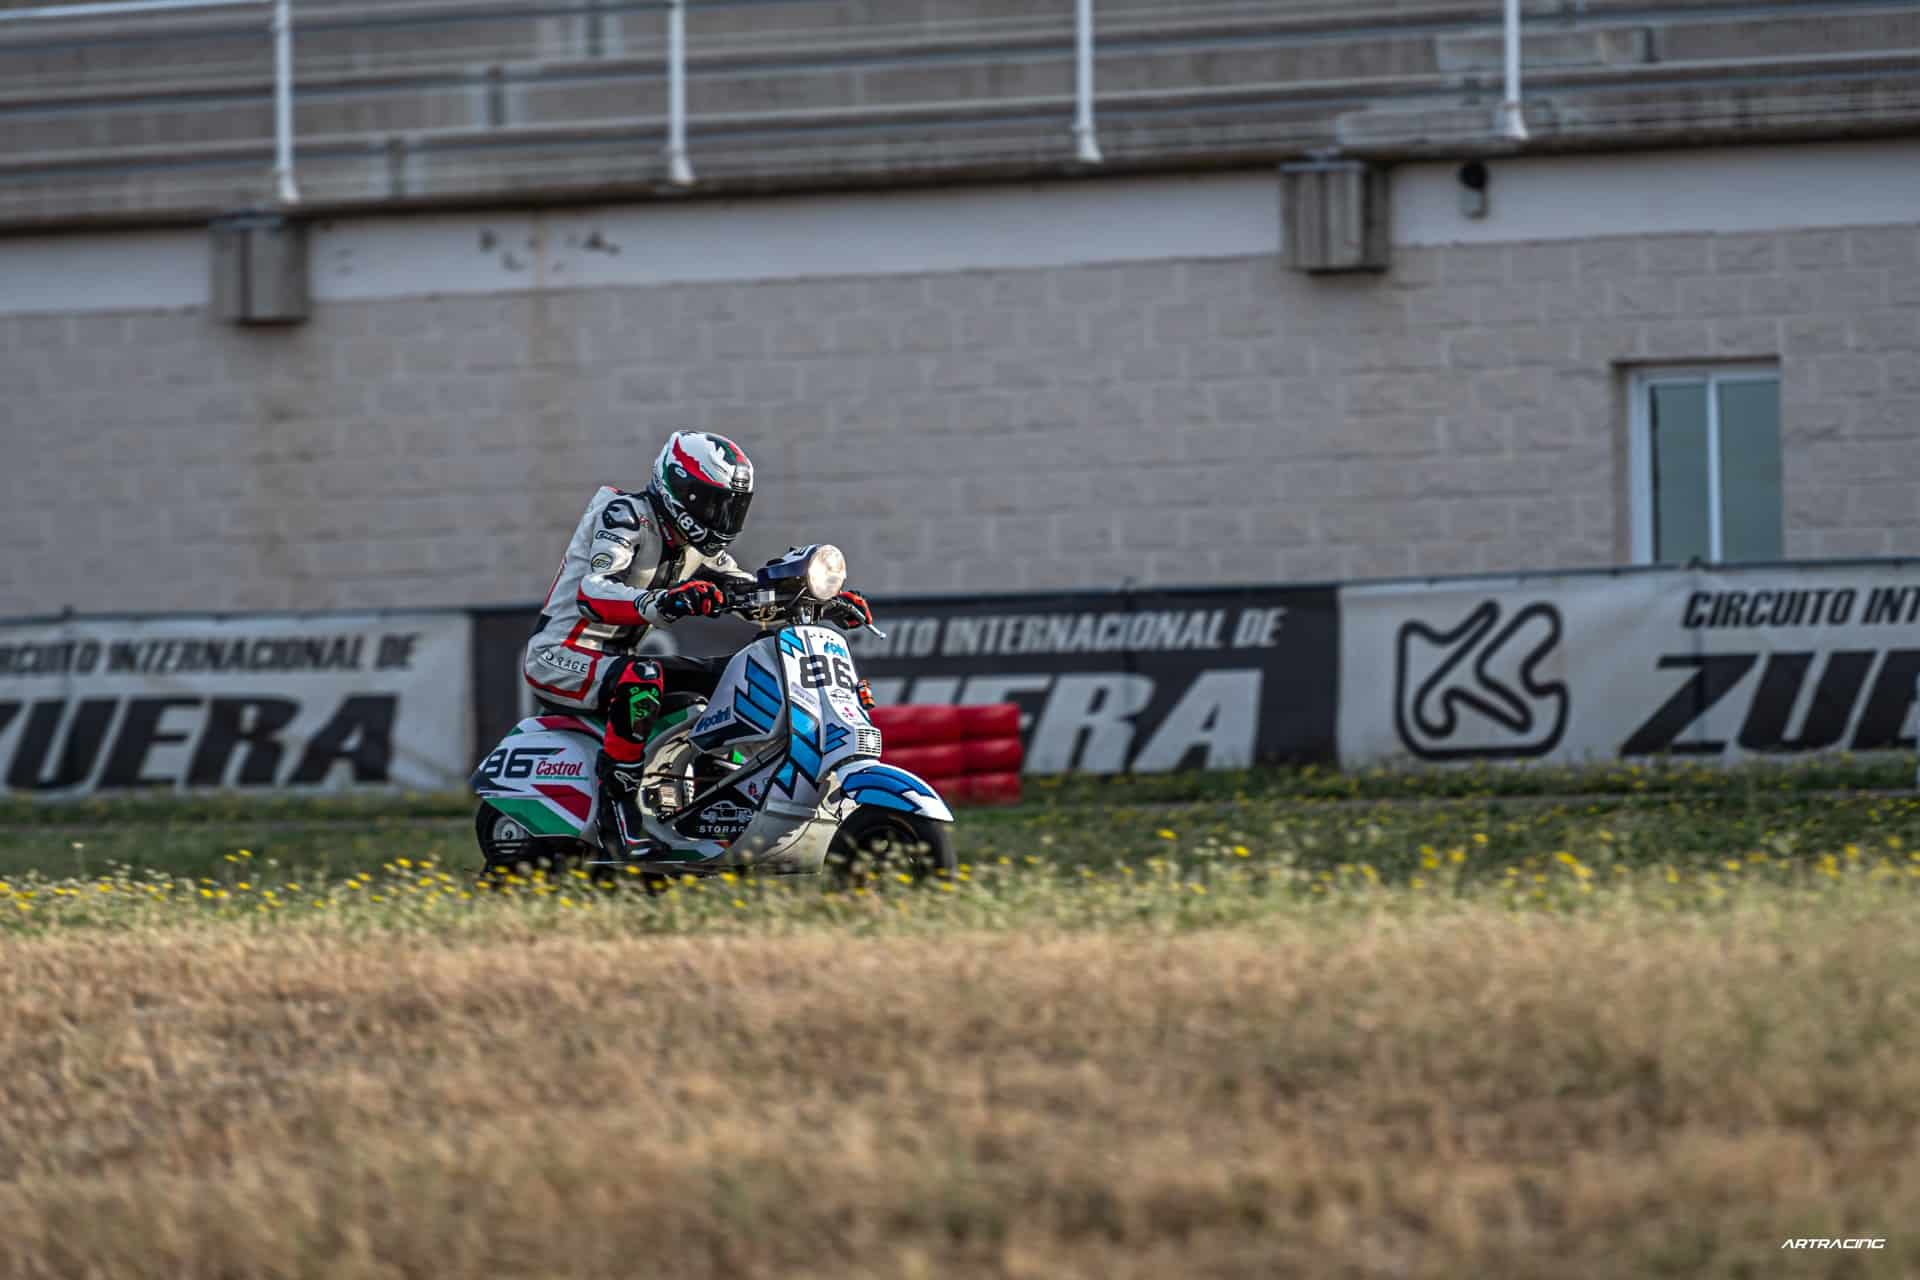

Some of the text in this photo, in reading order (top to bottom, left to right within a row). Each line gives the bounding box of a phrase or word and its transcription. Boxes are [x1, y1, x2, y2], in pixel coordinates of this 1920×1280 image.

[1682, 589, 1857, 630] CIRCUITO
[940, 609, 1221, 656] INTERNACIONAL
[1235, 607, 1286, 647] DE
[107, 636, 364, 673] INTERNACIONAL
[376, 634, 418, 668] DE
[799, 654, 857, 693] 86
[0, 693, 399, 789] UERA
[483, 747, 566, 778] 86
[535, 760, 584, 776] Castrol
